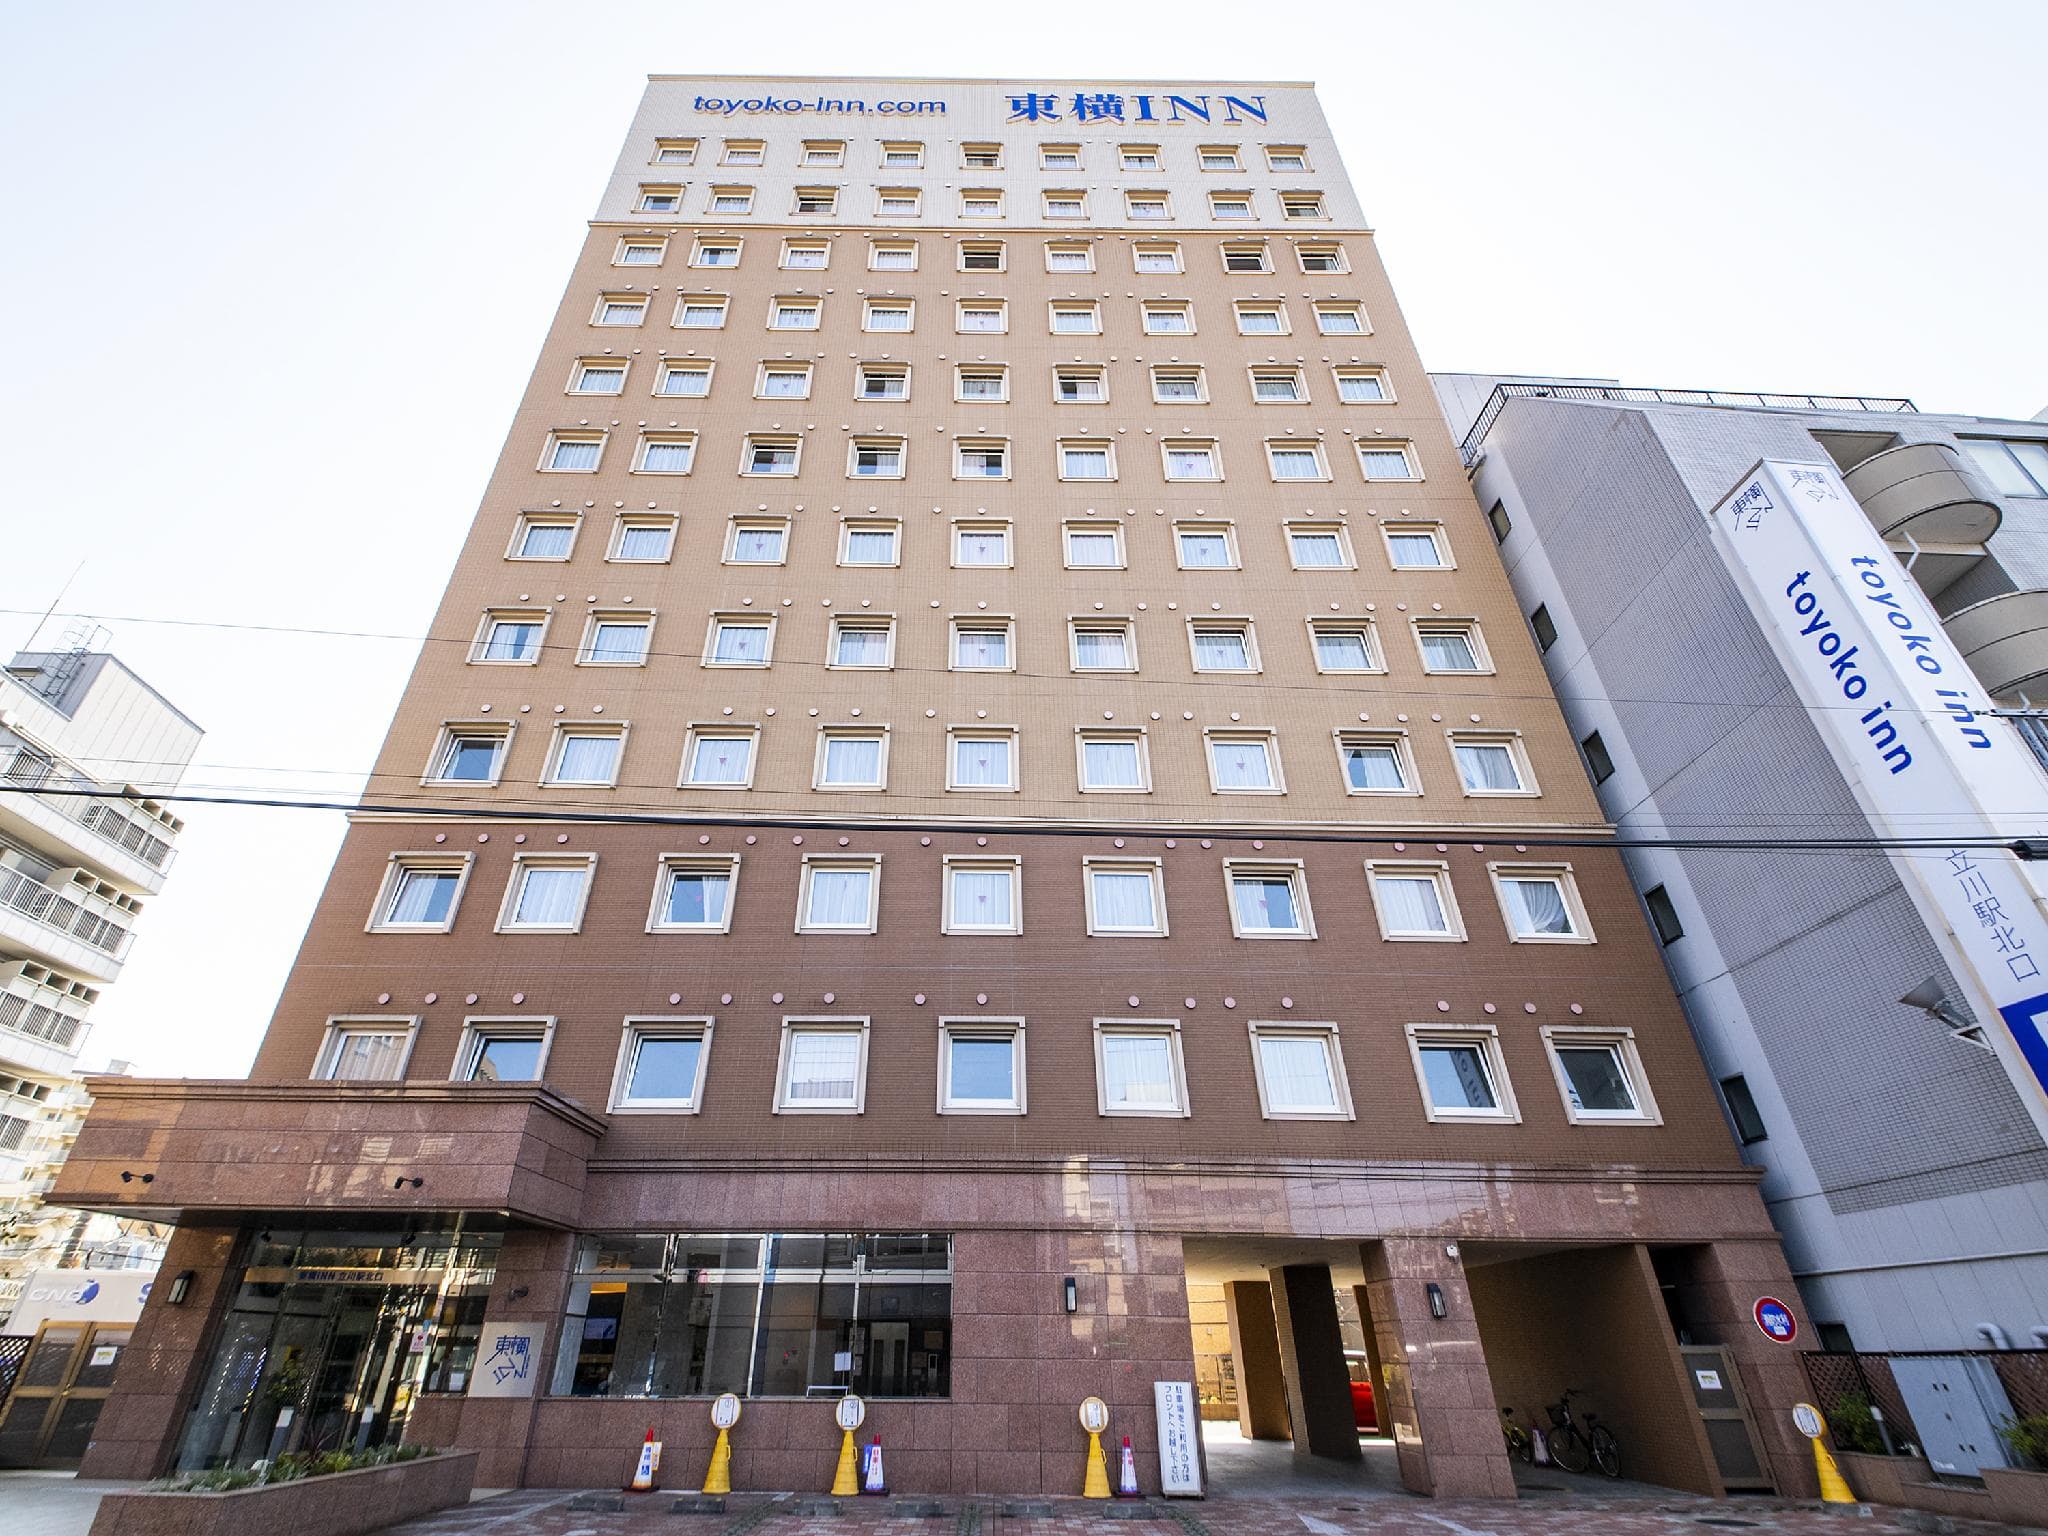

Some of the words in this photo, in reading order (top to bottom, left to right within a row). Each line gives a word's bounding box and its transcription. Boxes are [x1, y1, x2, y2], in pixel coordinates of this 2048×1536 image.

[692, 95, 948, 118] toyoko-inn.com
[1004, 92, 1269, 126] 東横INN
[1786, 570, 1867, 700] toyoko
[1860, 700, 1912, 775] inn
[1851, 555, 1942, 675] toyoko
[1935, 689, 1992, 749] inn
[1945, 848, 2041, 983] 立川駅北口
